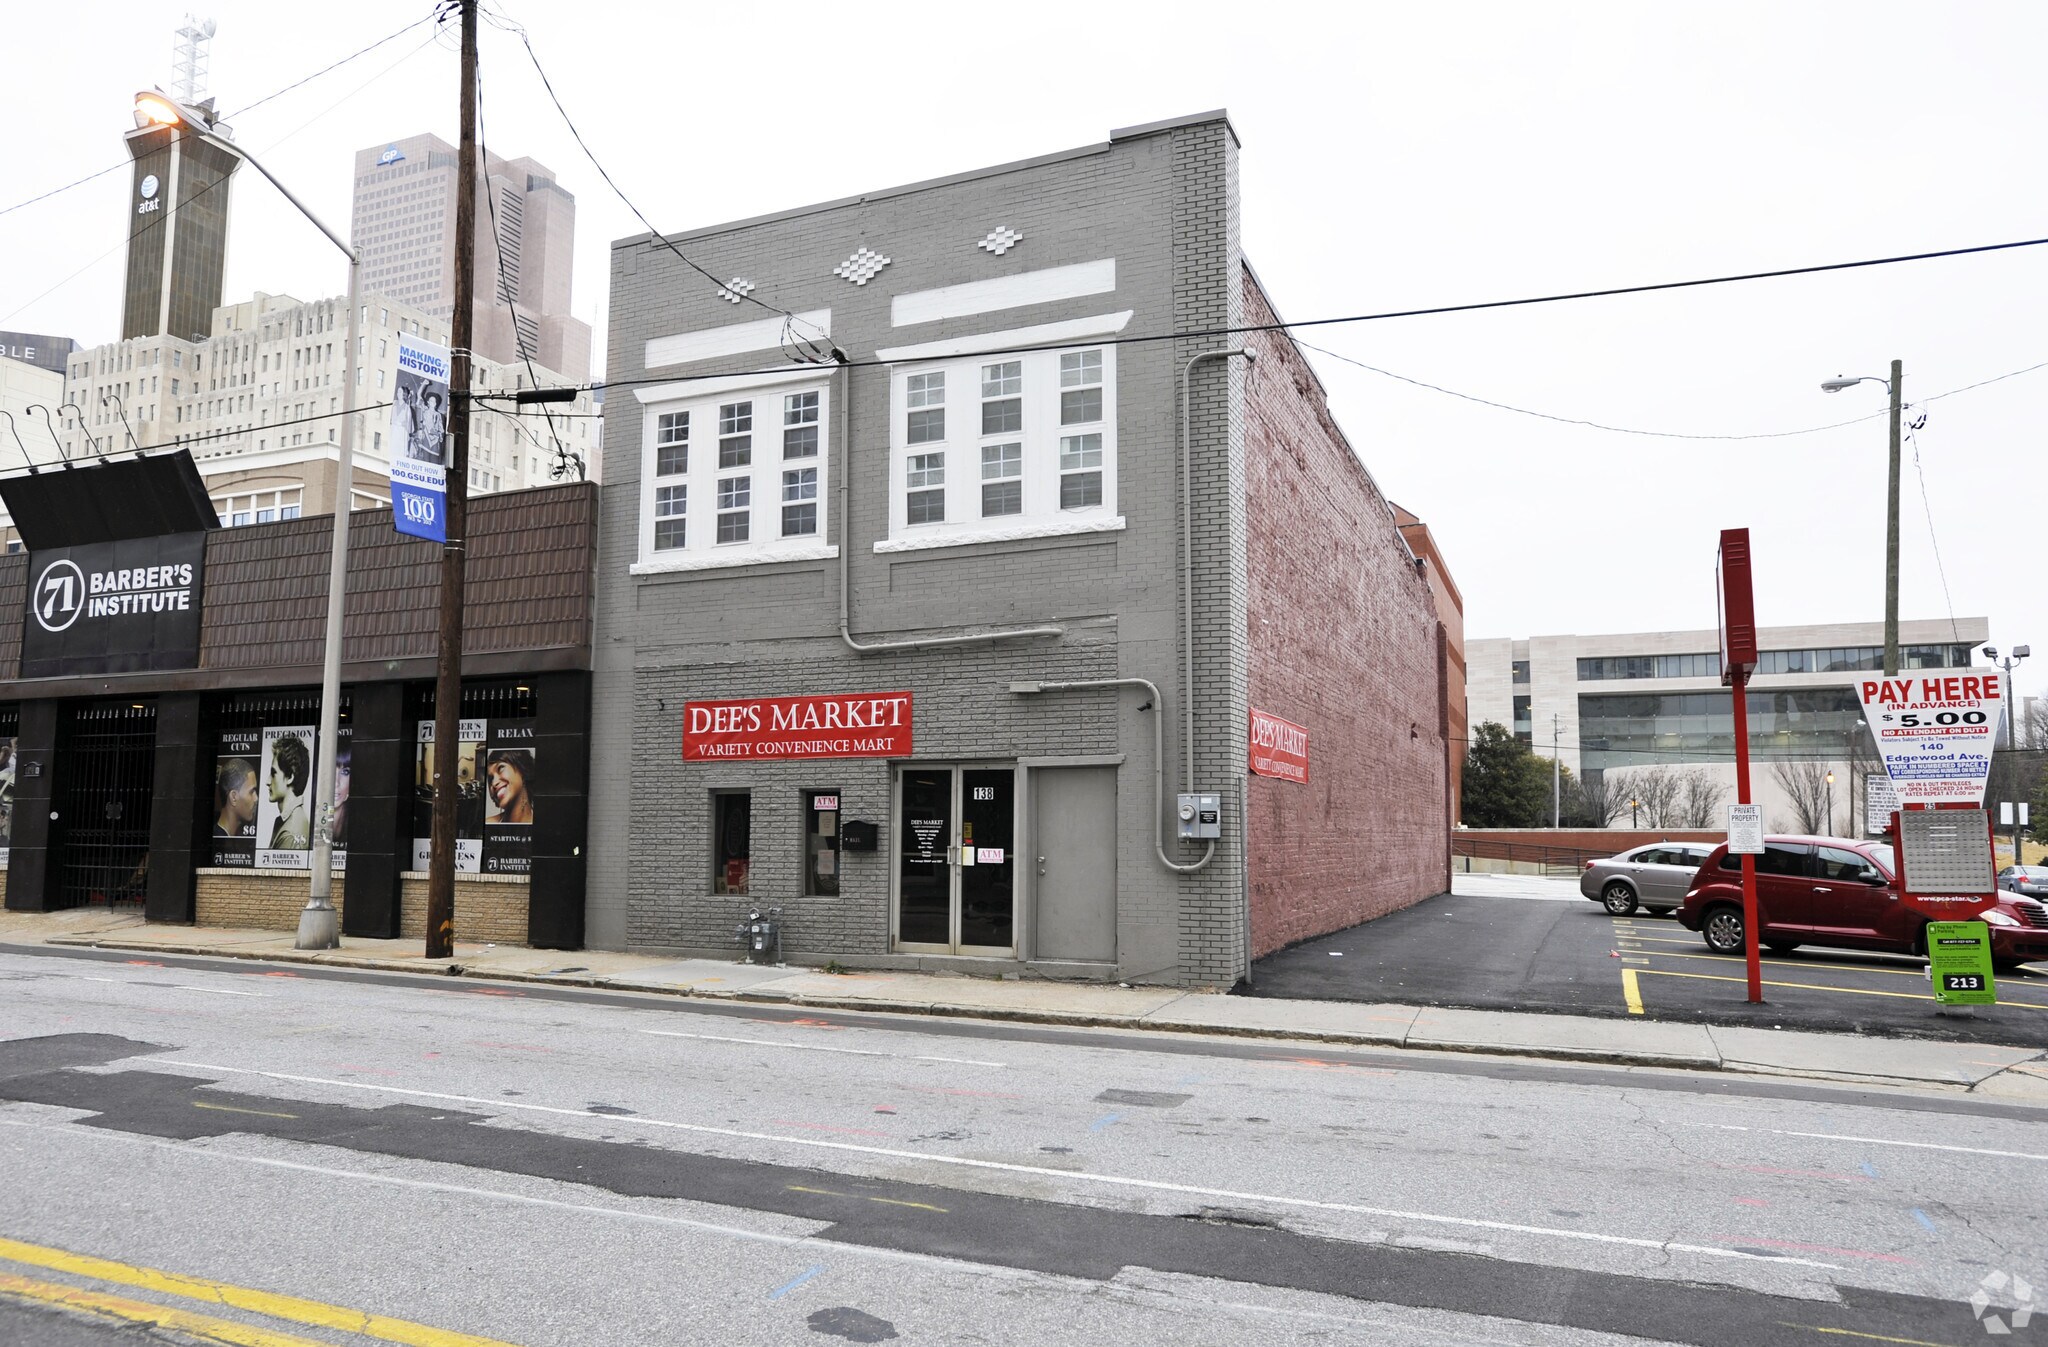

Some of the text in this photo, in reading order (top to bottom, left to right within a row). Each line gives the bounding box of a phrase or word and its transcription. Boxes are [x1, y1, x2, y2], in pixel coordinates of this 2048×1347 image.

[382, 150, 397, 162] GP
[138, 198, 159, 214] at&t
[400, 346, 442, 368] MAKING
[396, 460, 439, 475] FIND OUT HOW
[391, 468, 445, 486] 100.GSU.EDU
[401, 491, 421, 501] GEORGIA
[402, 497, 435, 521] 100
[89, 563, 193, 594] BARBER'S
[43, 575, 76, 620] 71
[88, 590, 191, 618] INSTITUTE
[1862, 675, 2000, 704] PAY HERE
[1887, 700, 1981, 711] (IN ADVANCE)
[689, 697, 908, 734] DEE'S MARKET
[1900, 711, 1987, 728] 5.00
[222, 733, 258, 743] REGULAR
[264, 729, 314, 739] PRECISION
[497, 728, 534, 739] RELAX
[1897, 728, 1946, 736] ATTENDANT
[230, 742, 251, 752] CUTS
[698, 737, 895, 757] VARIETY CONVENIENCE MART
[1275, 724, 1307, 758] MARKET
[1919, 743, 1944, 751] 140
[1255, 755, 1272, 771] VARIETY
[1886, 753, 1988, 763] Edgewood Ave.
[975, 787, 993, 799] 138
[816, 797, 836, 805] ATM
[1734, 806, 1755, 814] PRIVATE
[1731, 814, 1759, 822] PROPERTY
[1950, 977, 1978, 988] 213
